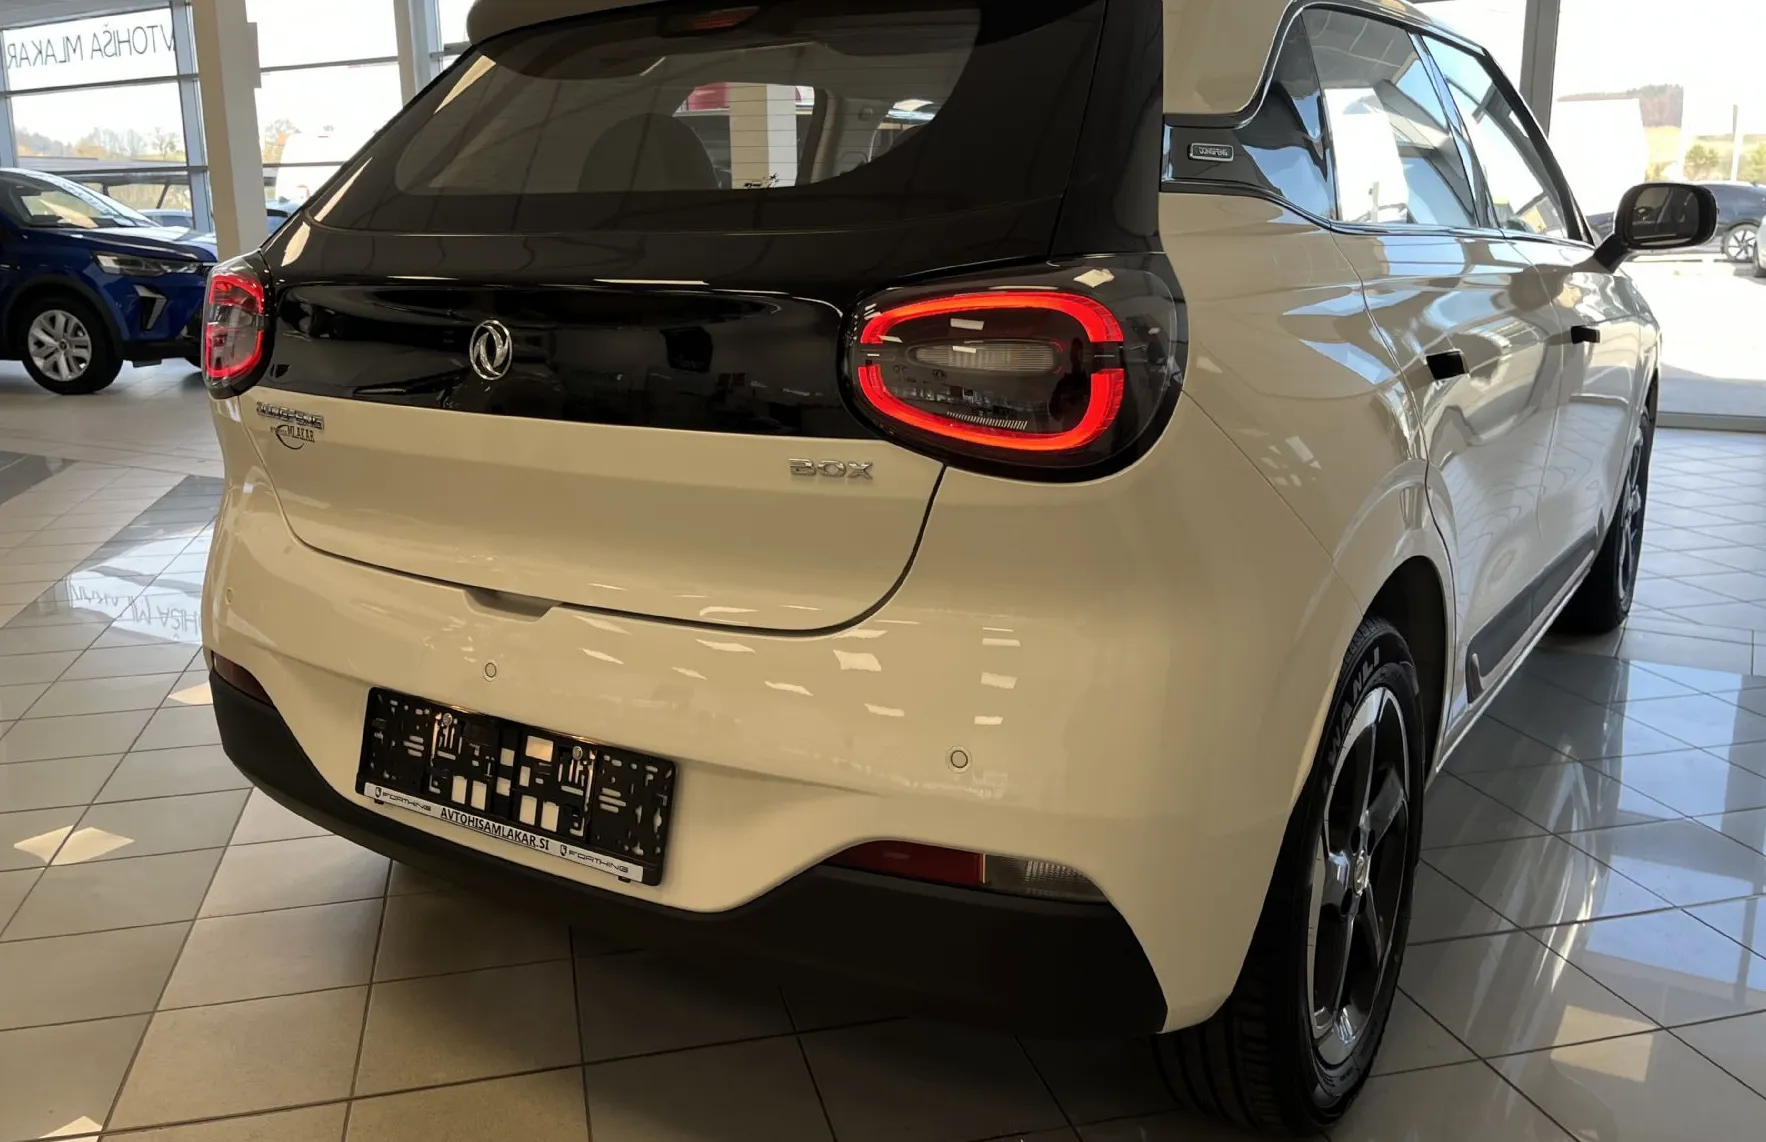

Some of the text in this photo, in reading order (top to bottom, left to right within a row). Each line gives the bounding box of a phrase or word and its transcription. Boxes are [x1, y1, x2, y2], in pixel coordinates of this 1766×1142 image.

[788, 457, 874, 480] BOX
[1327, 645, 1381, 768] WANLI
[382, 791, 629, 873] FORTHING AVTOHISAMLAKAR.SI FORTHING
